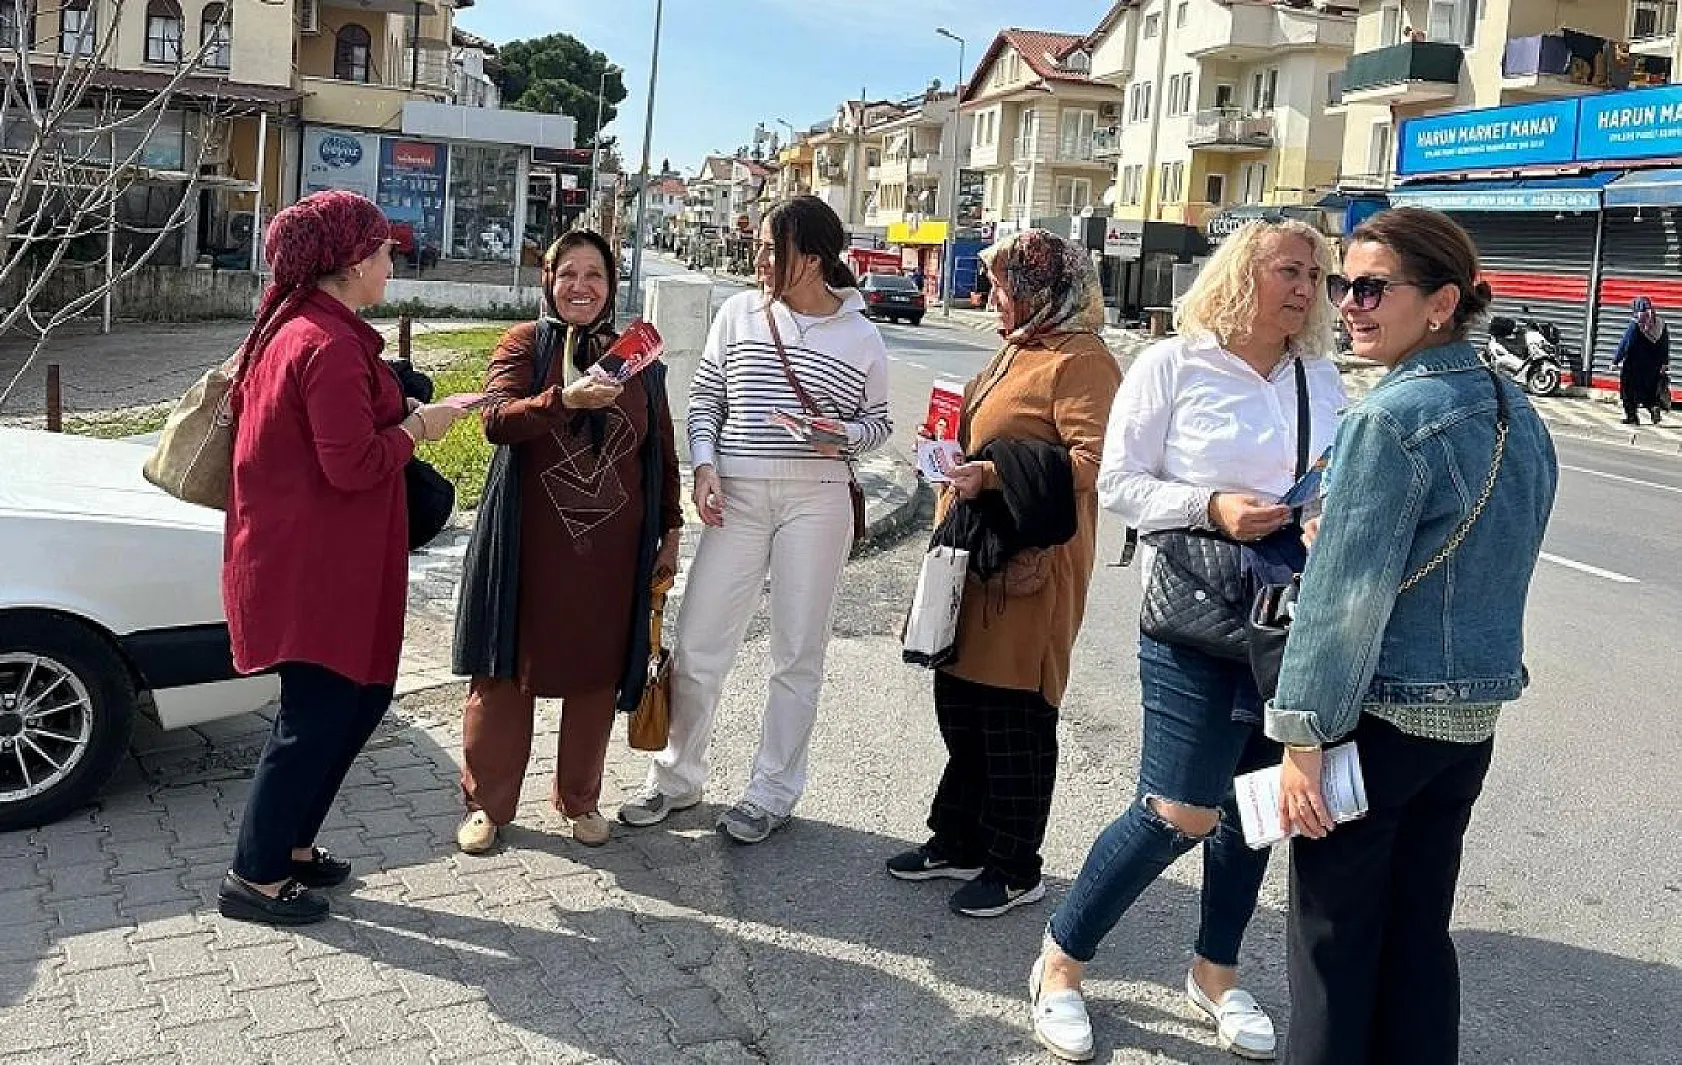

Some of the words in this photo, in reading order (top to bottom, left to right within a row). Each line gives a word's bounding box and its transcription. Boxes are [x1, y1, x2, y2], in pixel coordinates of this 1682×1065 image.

[1417, 128, 1456, 147] HARUN
[1458, 122, 1509, 143] MARKET
[1510, 116, 1557, 137] MANAV
[1598, 105, 1656, 130] HARUN
